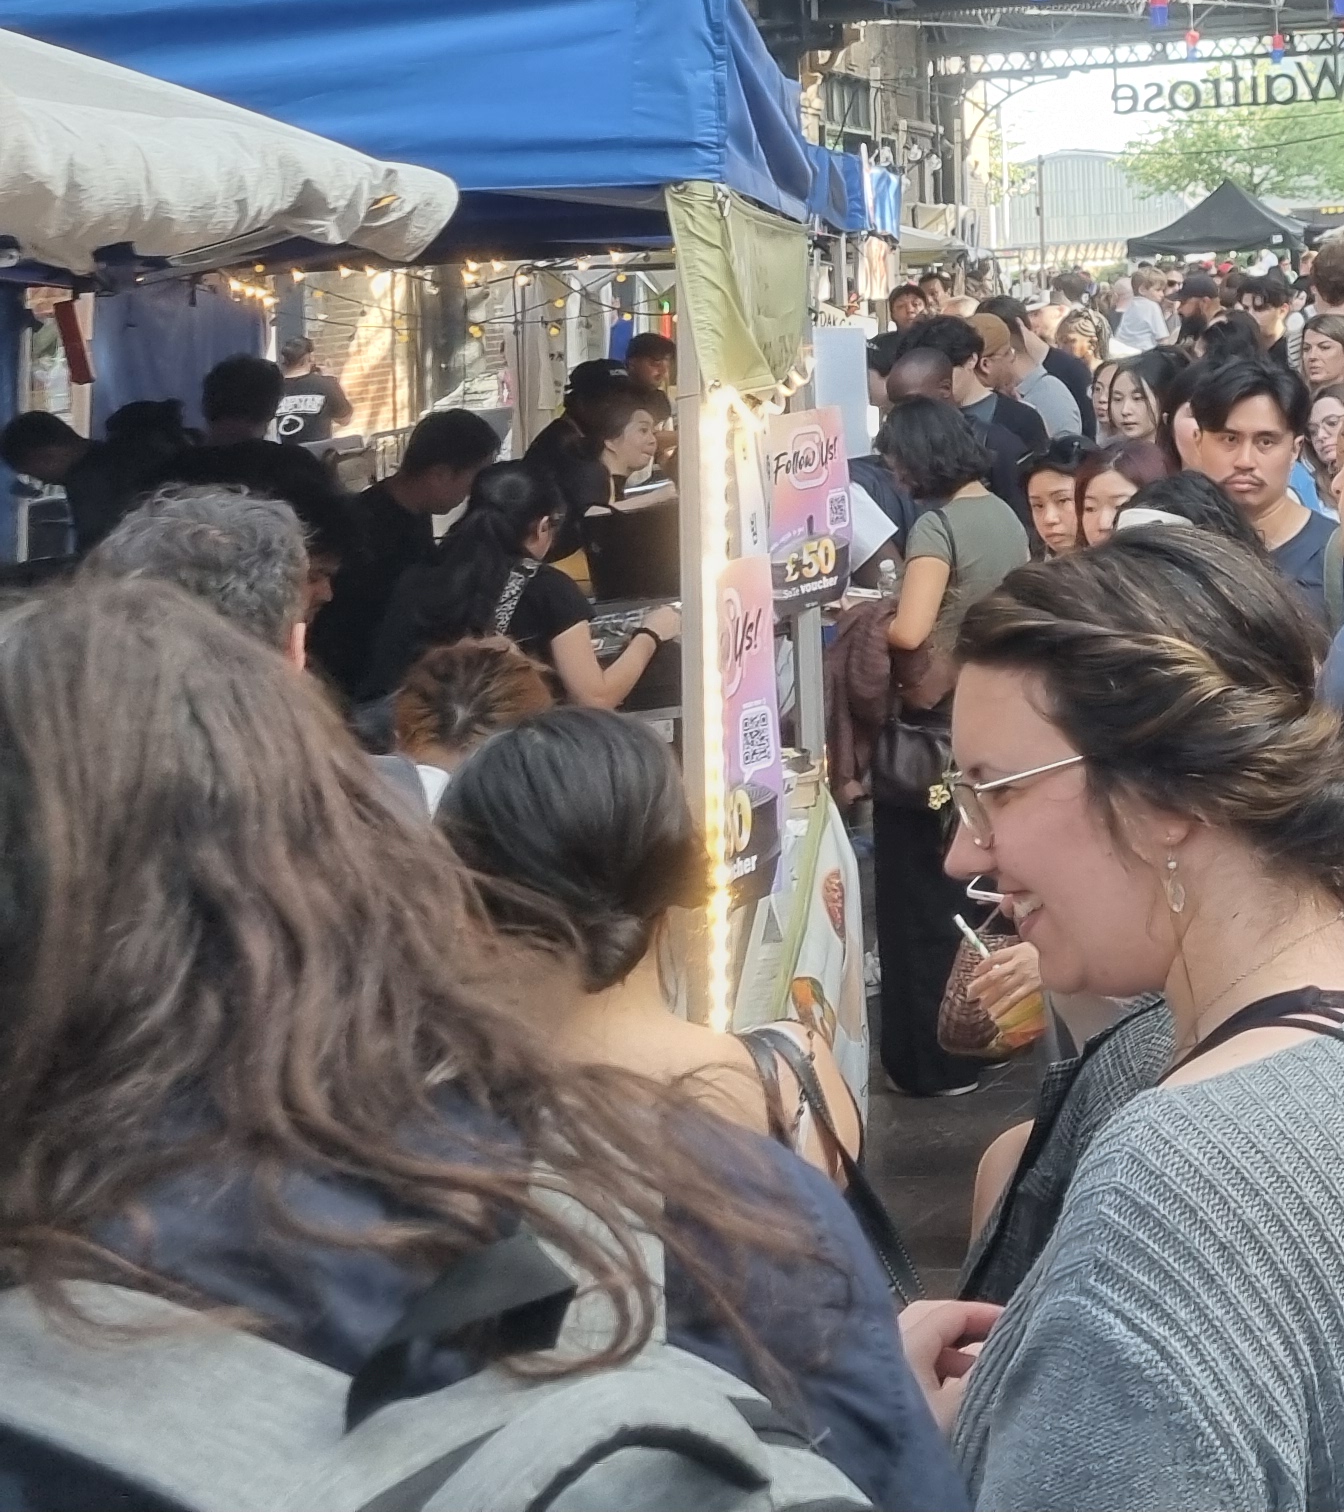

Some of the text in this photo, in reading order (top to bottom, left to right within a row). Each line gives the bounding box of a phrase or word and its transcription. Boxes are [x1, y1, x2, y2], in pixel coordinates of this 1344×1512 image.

[774, 451, 816, 484] Follow
[821, 437, 838, 468] Us!
[785, 538, 836, 582] £50
[734, 607, 762, 661] Us!
